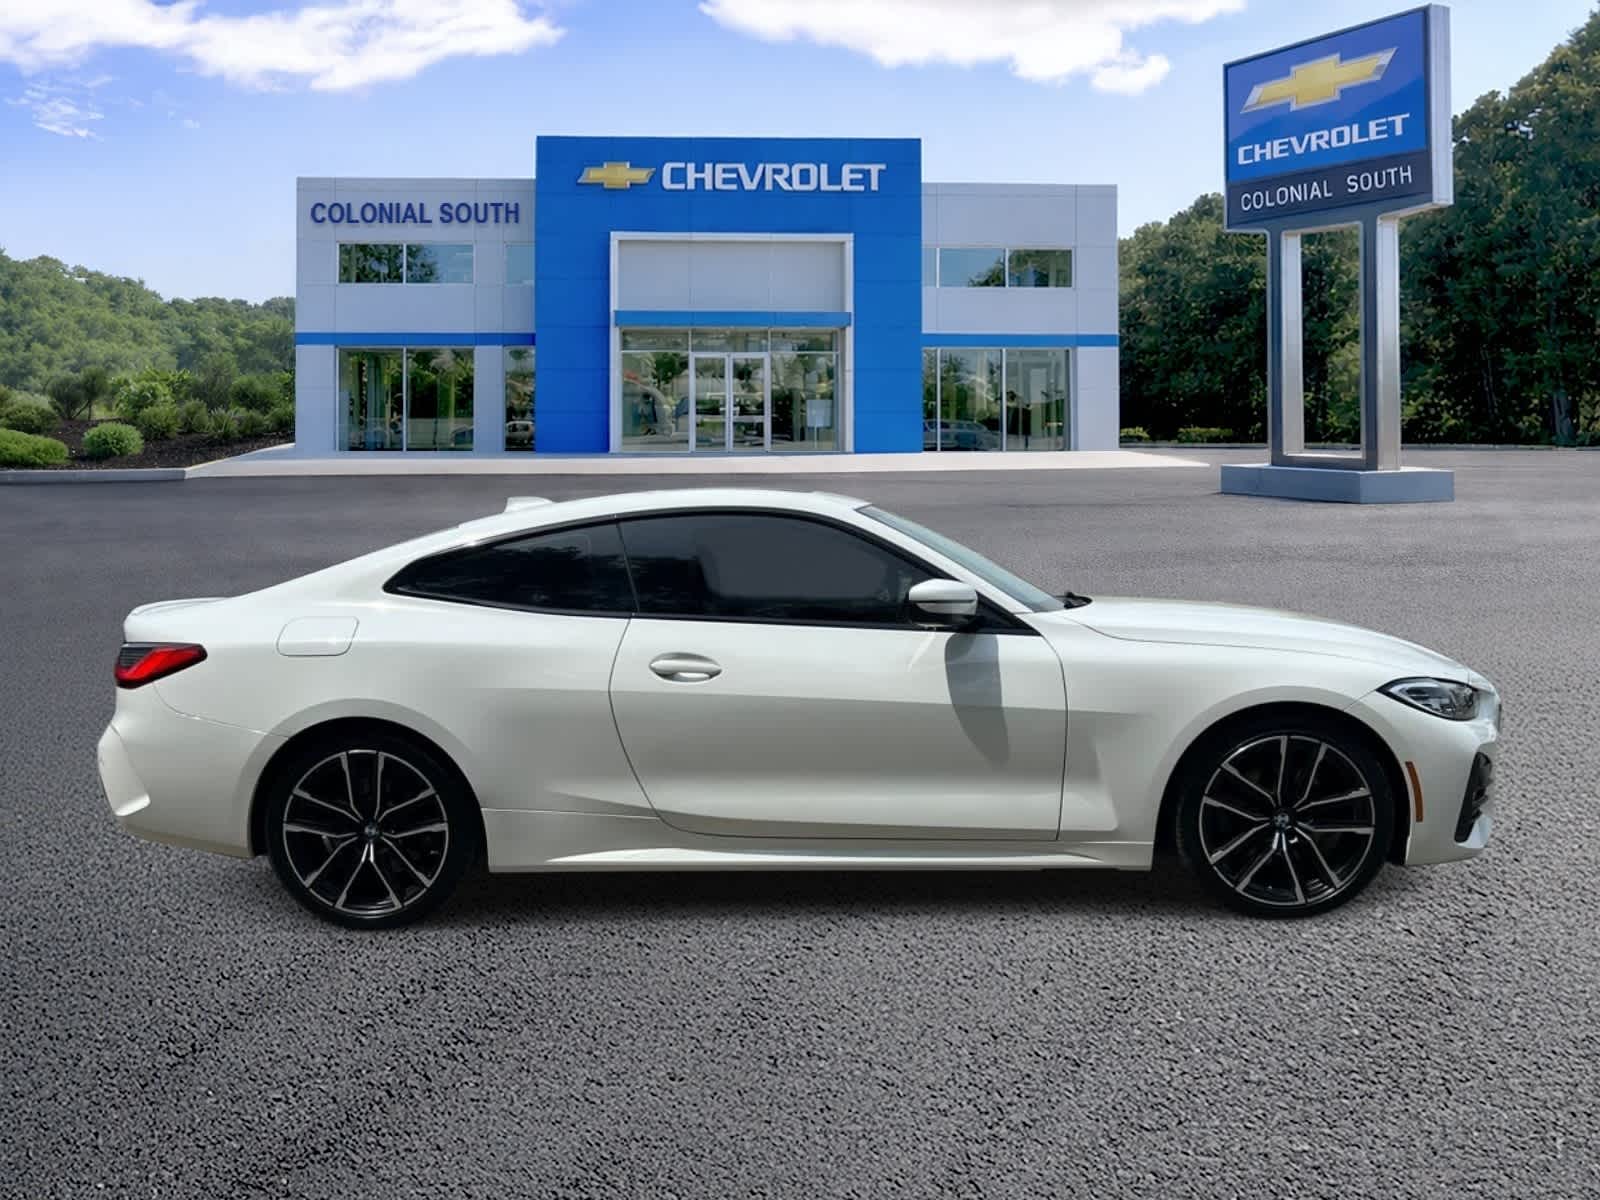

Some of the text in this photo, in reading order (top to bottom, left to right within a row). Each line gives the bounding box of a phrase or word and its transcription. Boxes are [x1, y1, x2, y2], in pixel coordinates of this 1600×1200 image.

[1237, 113, 1410, 165] CHEVROLET
[662, 162, 886, 192] CHEVROLET
[1241, 165, 1412, 211] COLONIAL SOUTH
[310, 202, 520, 224] COLONIAL SOUTH
